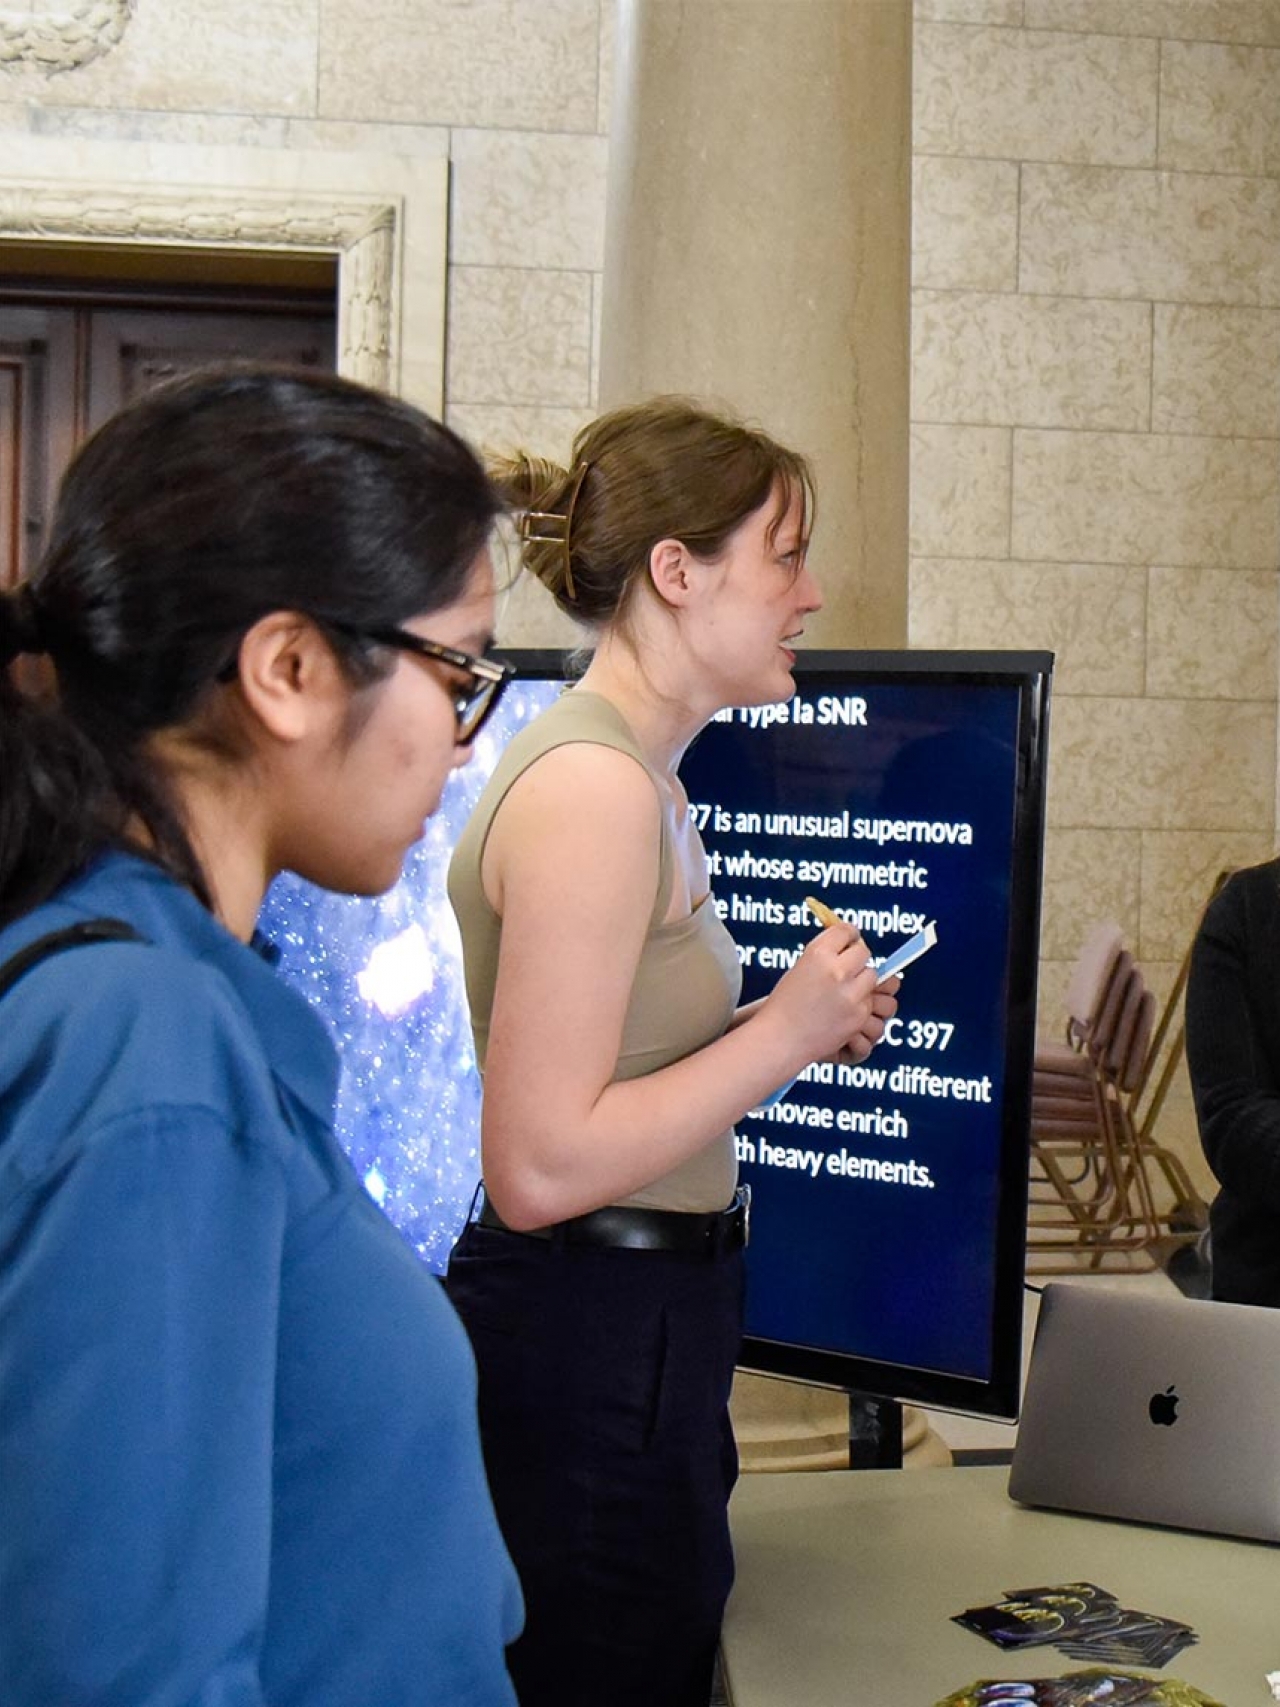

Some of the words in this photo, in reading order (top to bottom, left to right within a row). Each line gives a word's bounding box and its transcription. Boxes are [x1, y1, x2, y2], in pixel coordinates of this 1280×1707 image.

[708, 706, 733, 723] al
[816, 696, 868, 726] SNR
[714, 805, 732, 832] is
[734, 811, 761, 834] an
[764, 810, 850, 839] unusual
[852, 817, 973, 846] supernova
[724, 849, 795, 880] whose
[797, 859, 928, 888] asymmetric
[732, 893, 784, 925] hints
[787, 900, 811, 926] at
[876, 1017, 904, 1047] C
[906, 1019, 955, 1051] 397
[889, 1064, 992, 1103] different
[747, 1101, 834, 1130] novae
[836, 1106, 908, 1139] enrich
[758, 1136, 825, 1178] heavy
[826, 1147, 935, 1188] elements.
